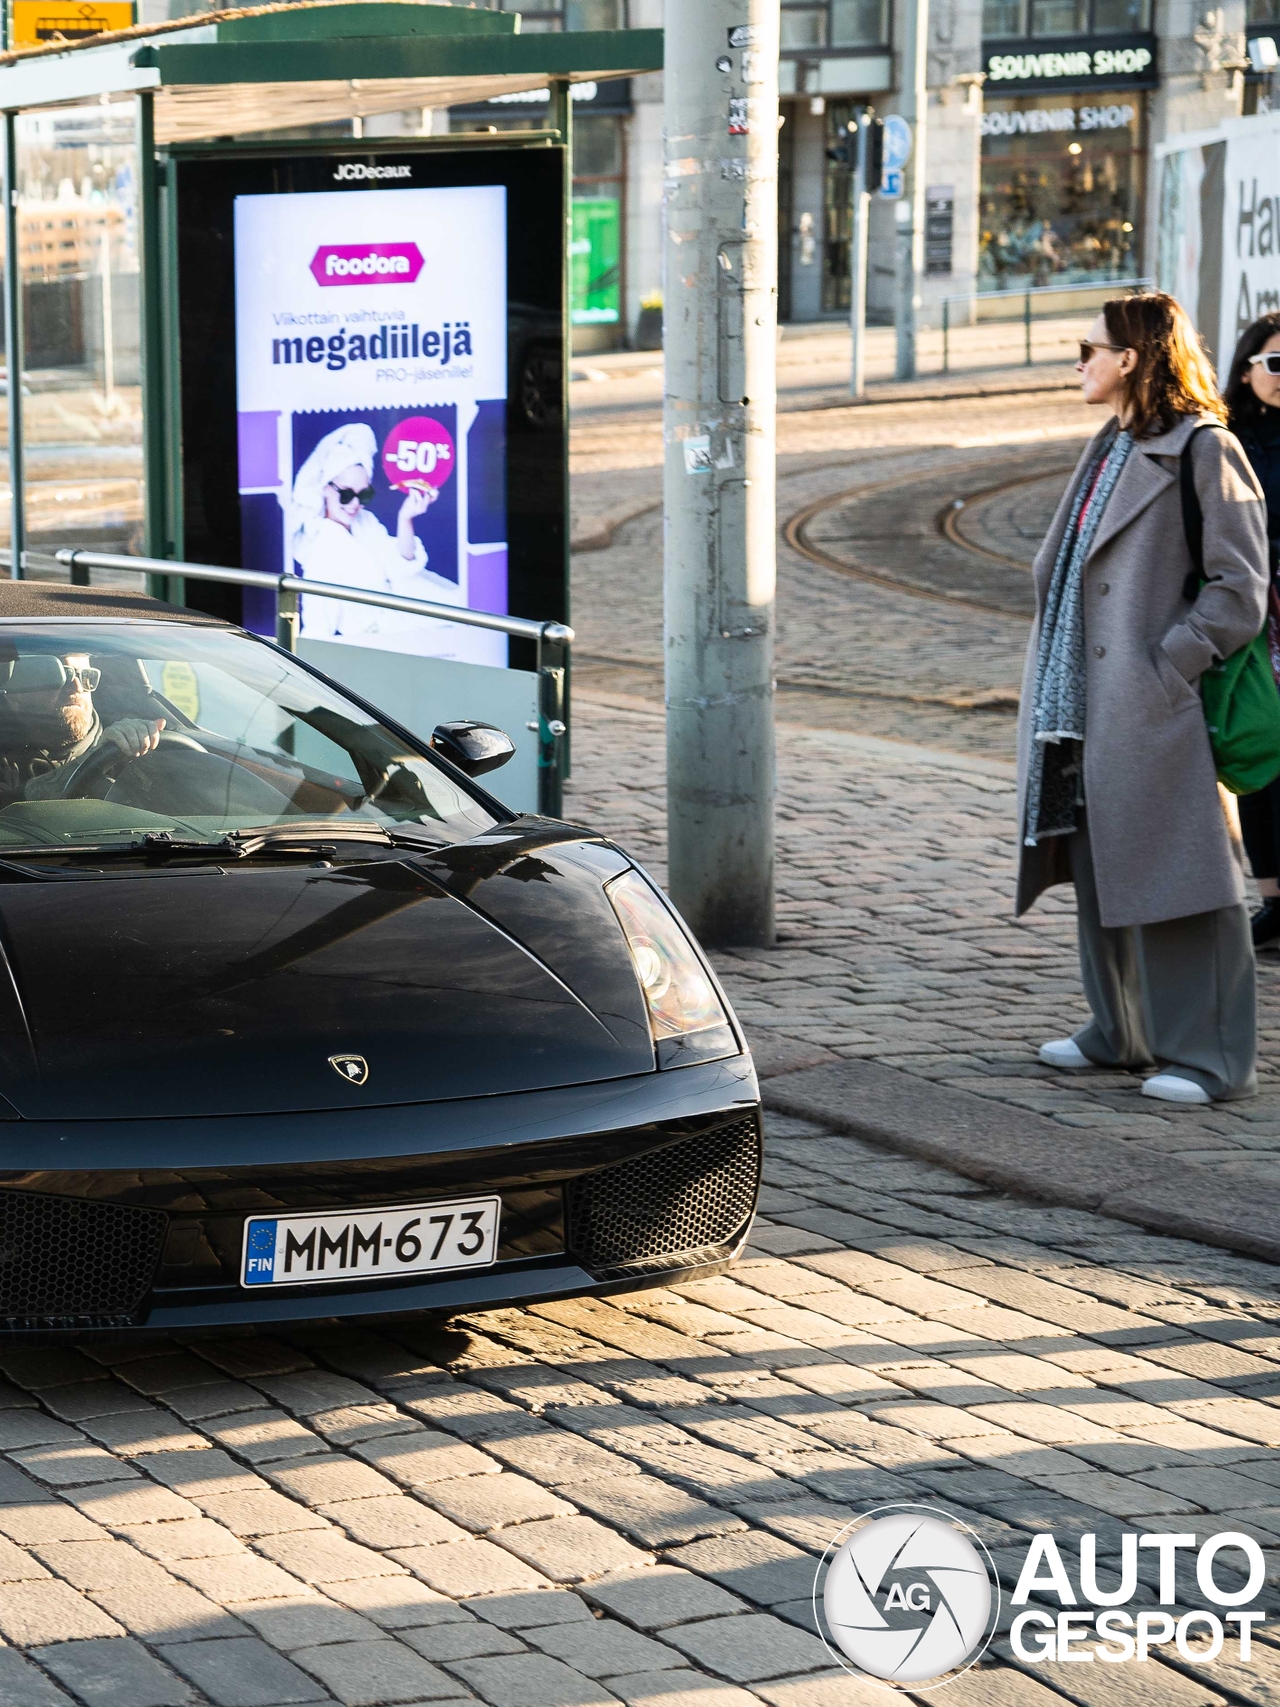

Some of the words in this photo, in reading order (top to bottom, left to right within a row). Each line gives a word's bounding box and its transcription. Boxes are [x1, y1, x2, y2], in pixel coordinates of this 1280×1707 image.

[988, 51, 1092, 81] SOUVENIR
[1093, 47, 1152, 75] SHOP
[981, 108, 1075, 136] SOUVENIR
[1079, 104, 1134, 131] SHOP
[333, 164, 412, 180] JCDecaux
[325, 253, 410, 276] foodora
[272, 310, 339, 326] Viikottain
[344, 308, 406, 323] vaihtuvia
[272, 321, 473, 371] megadiilejä
[376, 365, 473, 384] PRO-jäsenille!
[385, 439, 451, 473] -50%
[284, 1210, 486, 1273] MMM-673
[248, 1258, 272, 1272] FIN
